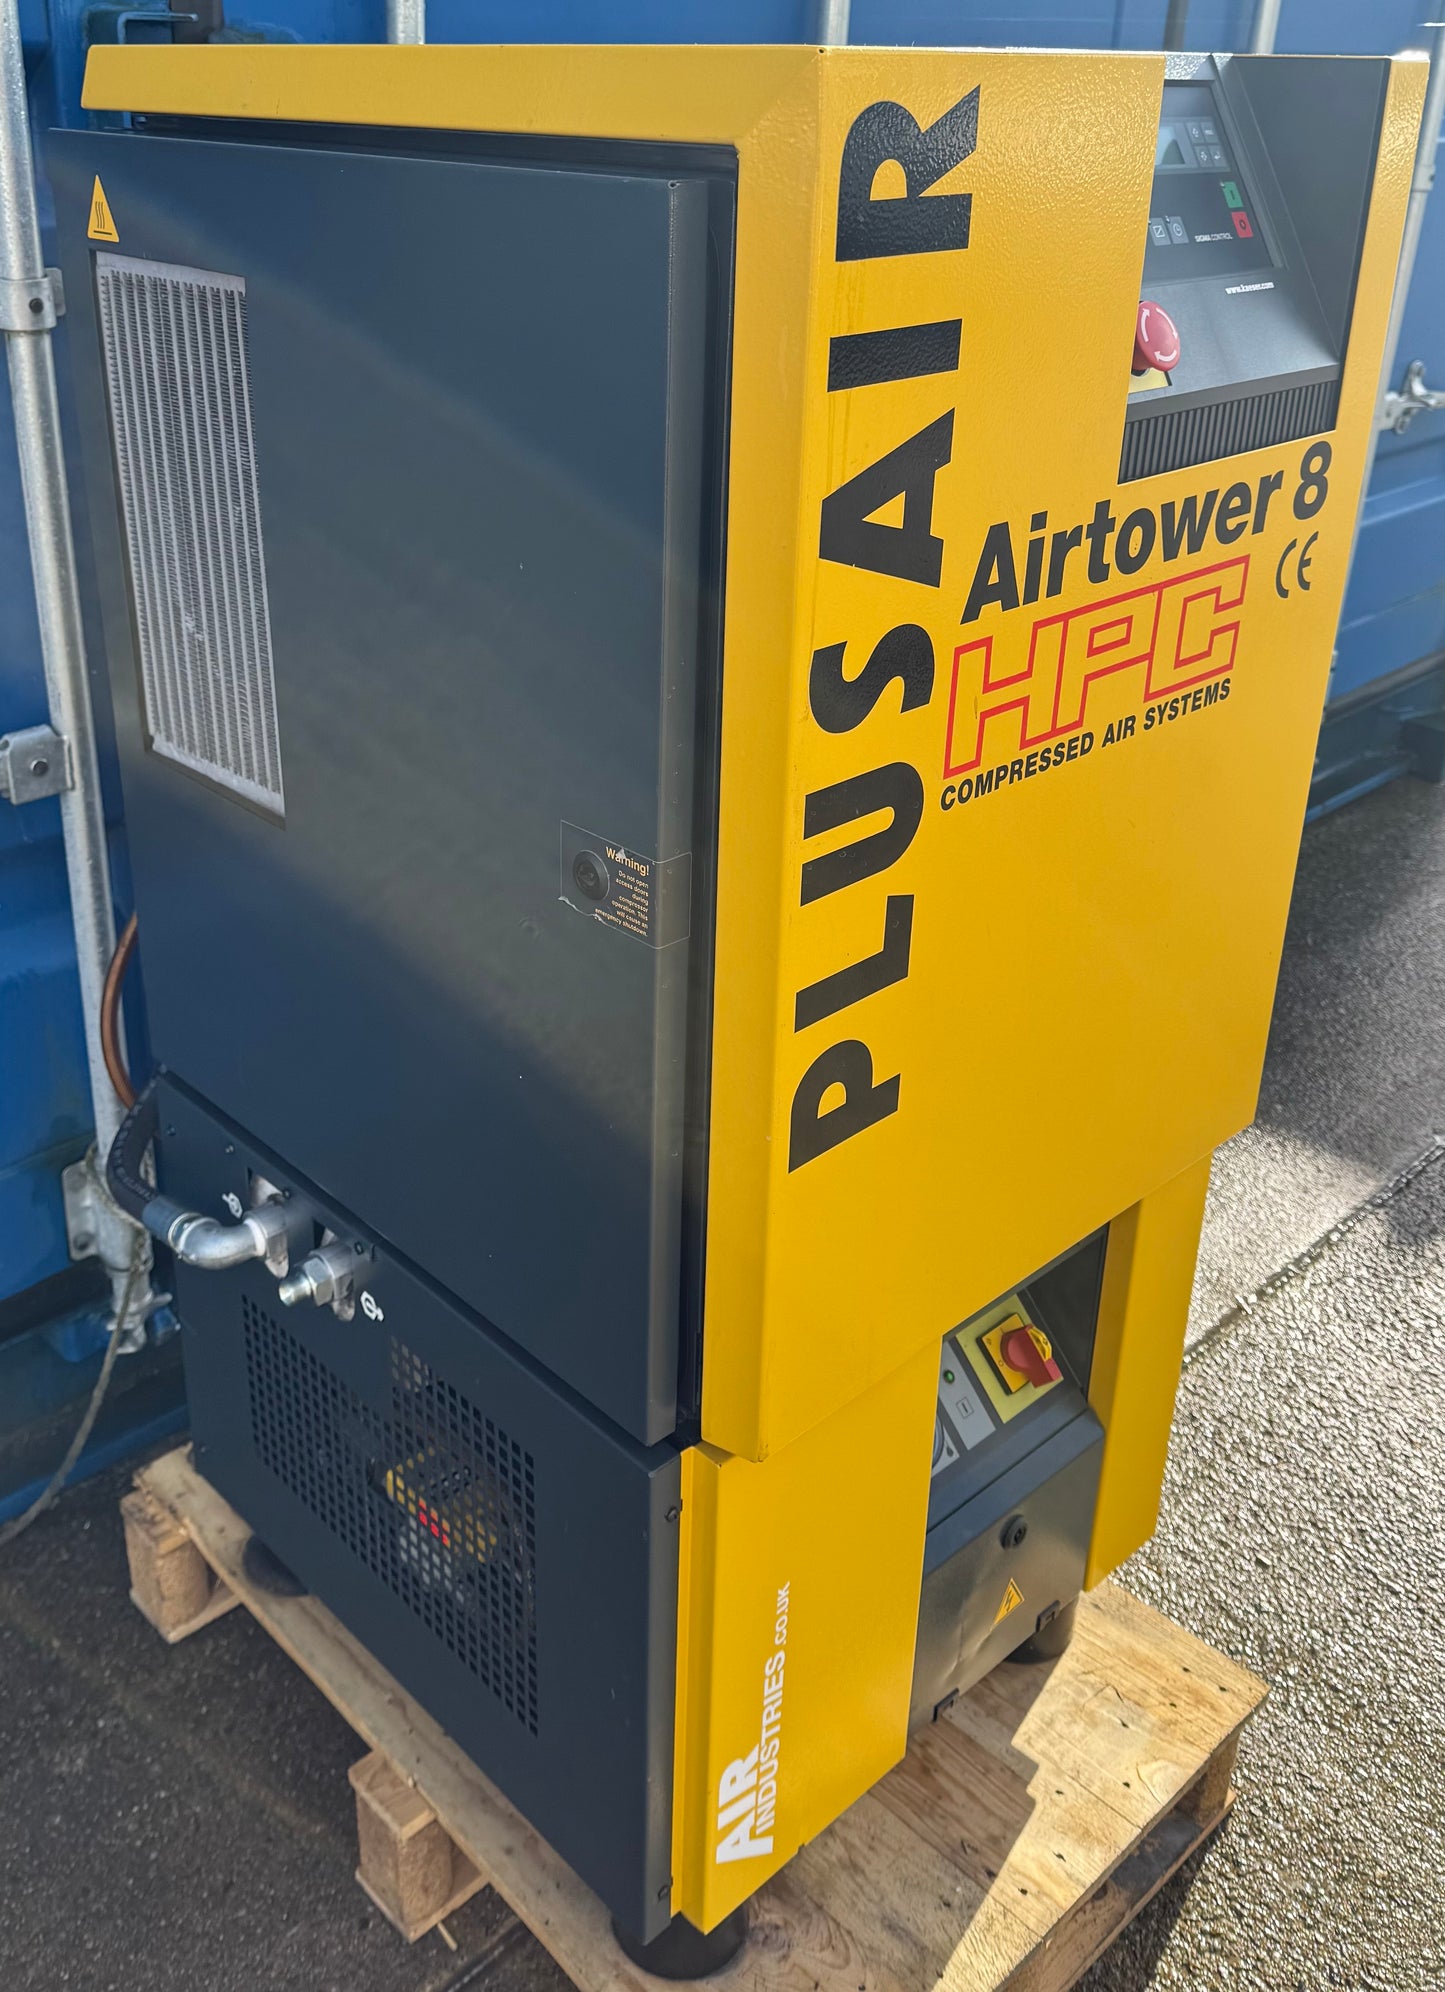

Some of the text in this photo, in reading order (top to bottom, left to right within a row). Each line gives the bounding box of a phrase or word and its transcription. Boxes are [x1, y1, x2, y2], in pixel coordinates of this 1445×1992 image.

[960, 441, 1332, 624] Airtower 8
[1276, 531, 1318, 598] CE
[788, 85, 980, 1172] PLUSAIR
[943, 554, 1250, 780] HPC
[941, 678, 1231, 811] COMPRESSED AIR SYSTEMS
[616, 878, 649, 897] access doors
[618, 870, 648, 889] Do not open
[619, 895, 648, 913] compressor
[632, 893, 648, 906] during
[595, 908, 622, 925] emergency
[616, 910, 648, 930] will cause an
[637, 911, 648, 921] This
[716, 1743, 773, 1865] AIR
